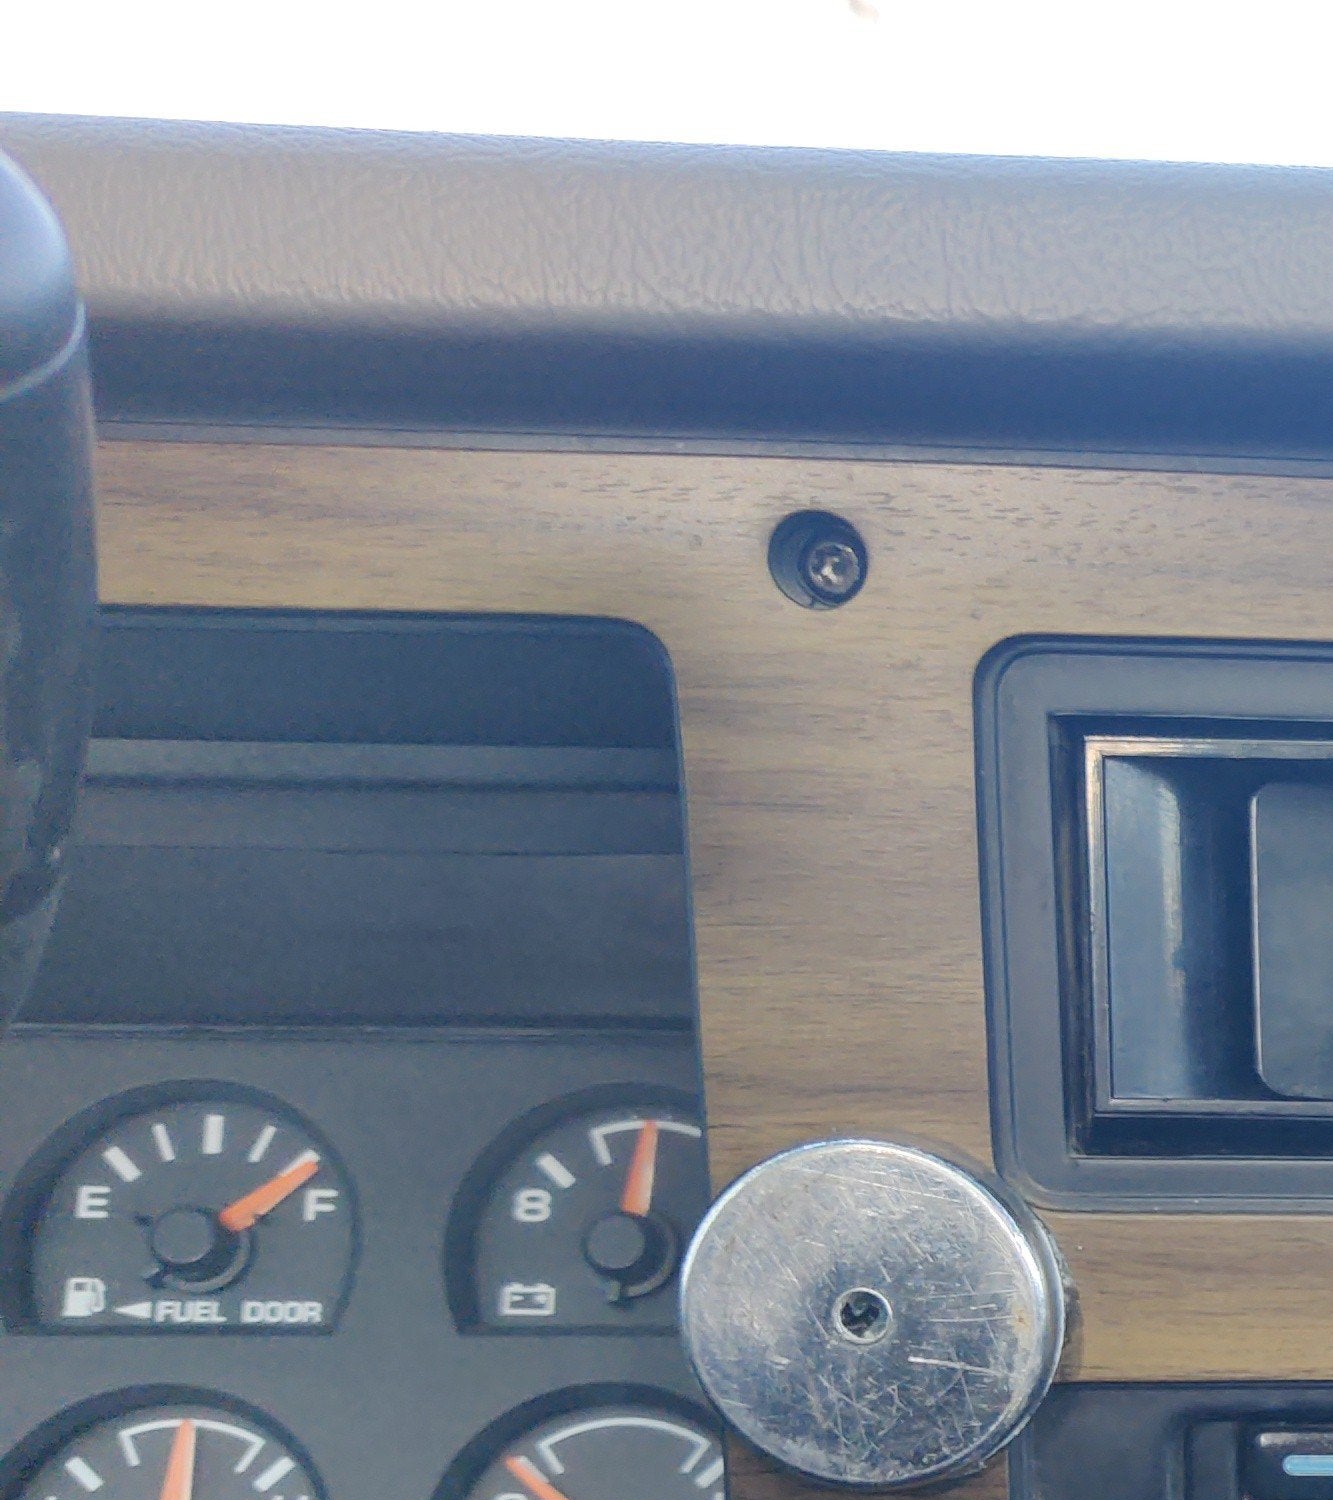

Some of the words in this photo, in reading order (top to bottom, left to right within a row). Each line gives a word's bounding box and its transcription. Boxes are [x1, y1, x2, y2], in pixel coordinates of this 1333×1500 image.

[76, 1185, 110, 1218] E
[303, 1188, 338, 1221] F
[155, 1299, 226, 1323] FUEL
[241, 1300, 323, 1324] DOOR
